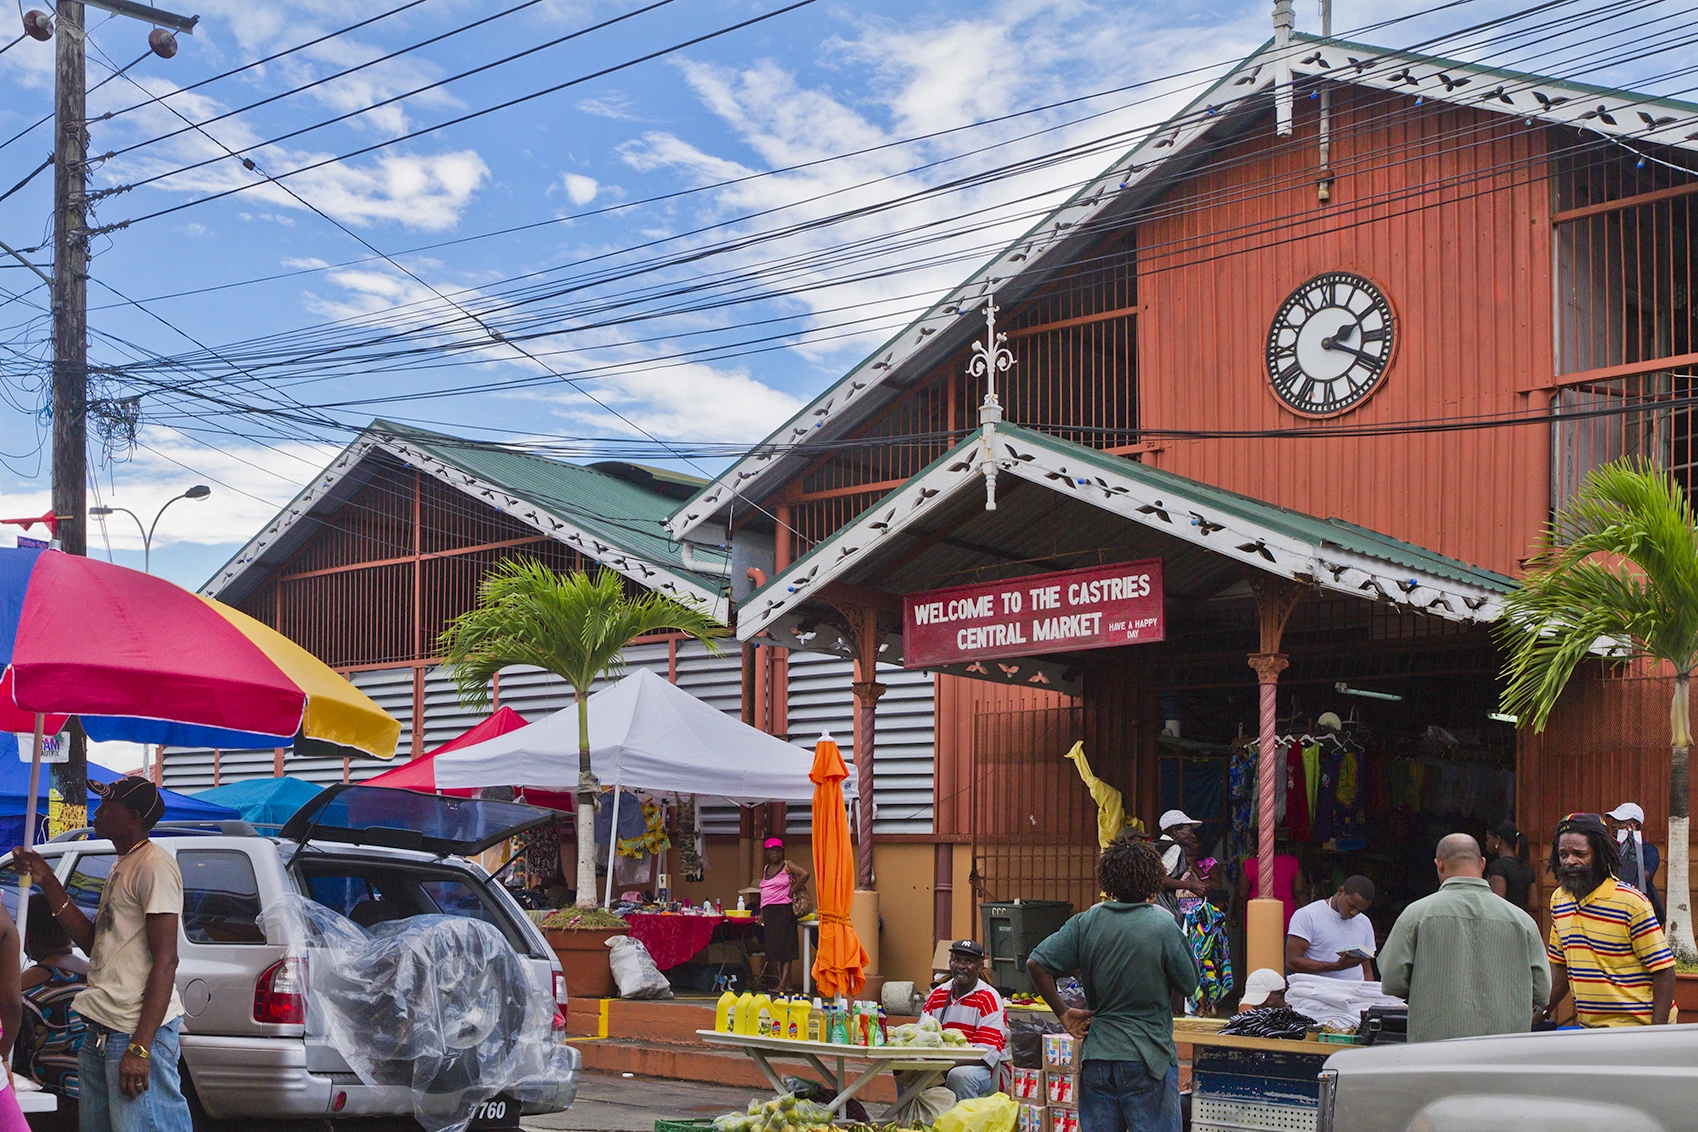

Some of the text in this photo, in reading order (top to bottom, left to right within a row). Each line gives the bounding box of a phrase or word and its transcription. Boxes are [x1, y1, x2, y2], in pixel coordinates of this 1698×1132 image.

[914, 573, 1150, 626] WELCOME TO THE CASTRIES
[957, 612, 1102, 650] CENTRAL MARKET
[1108, 617, 1158, 632] HAVE A HAPPY
[1126, 629, 1139, 639] DAY
